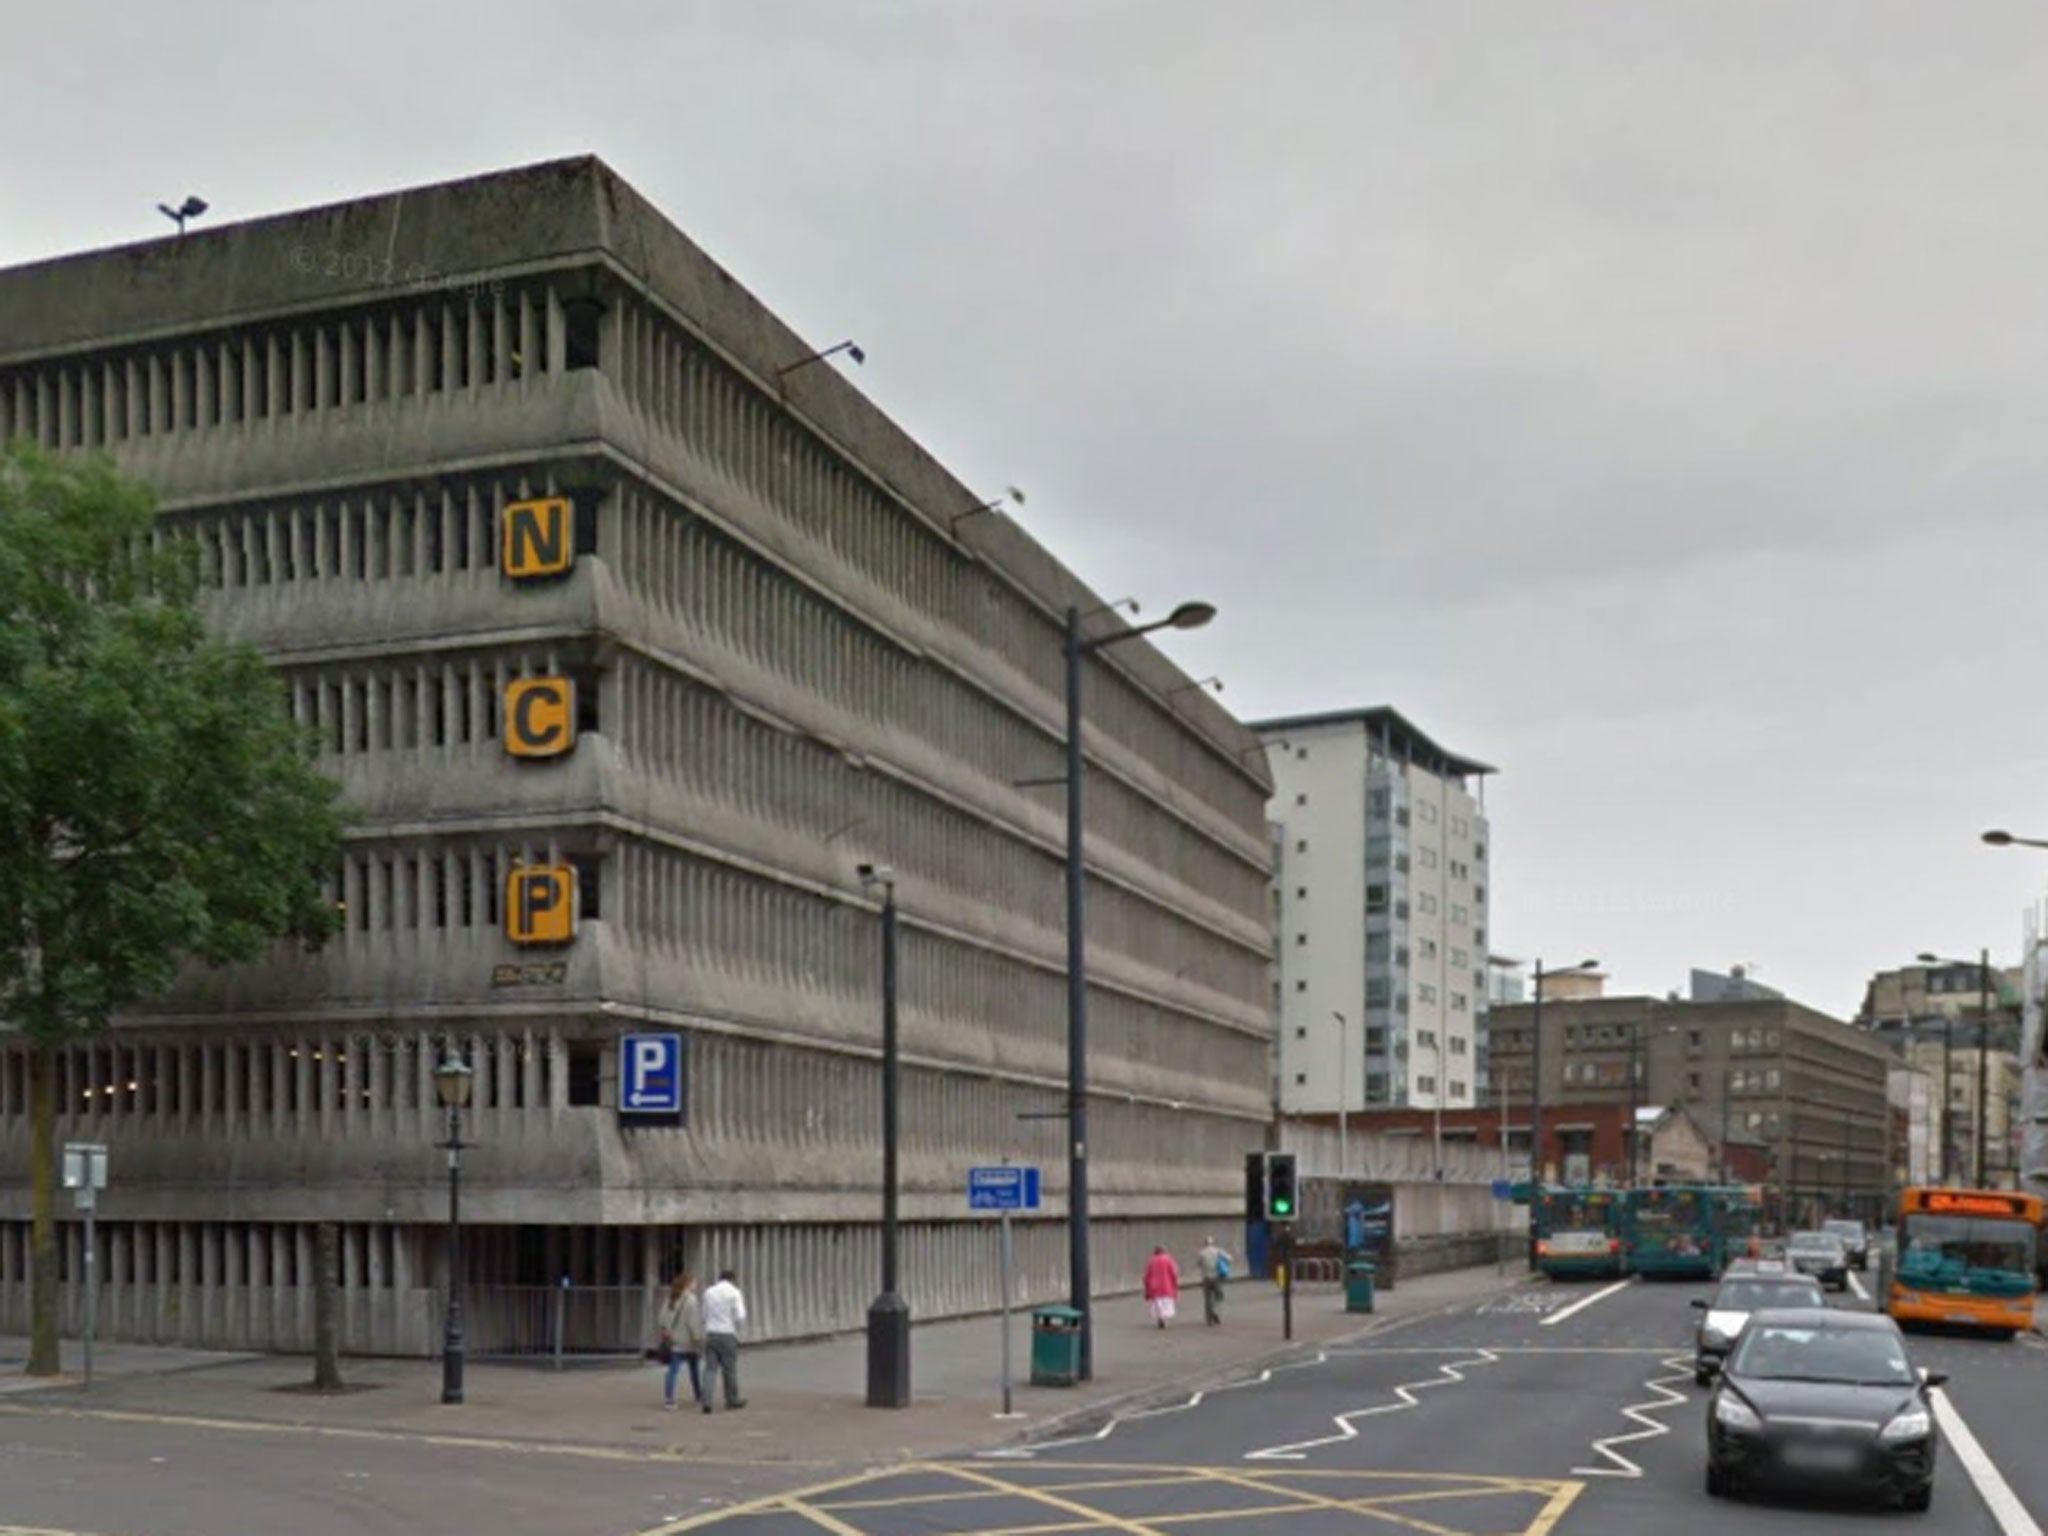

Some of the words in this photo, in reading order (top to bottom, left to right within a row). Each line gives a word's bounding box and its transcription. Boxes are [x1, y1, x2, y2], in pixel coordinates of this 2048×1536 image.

[511, 506, 562, 569] N
[515, 685, 562, 746] C
[518, 875, 561, 935] P
[635, 1041, 666, 1090] P
